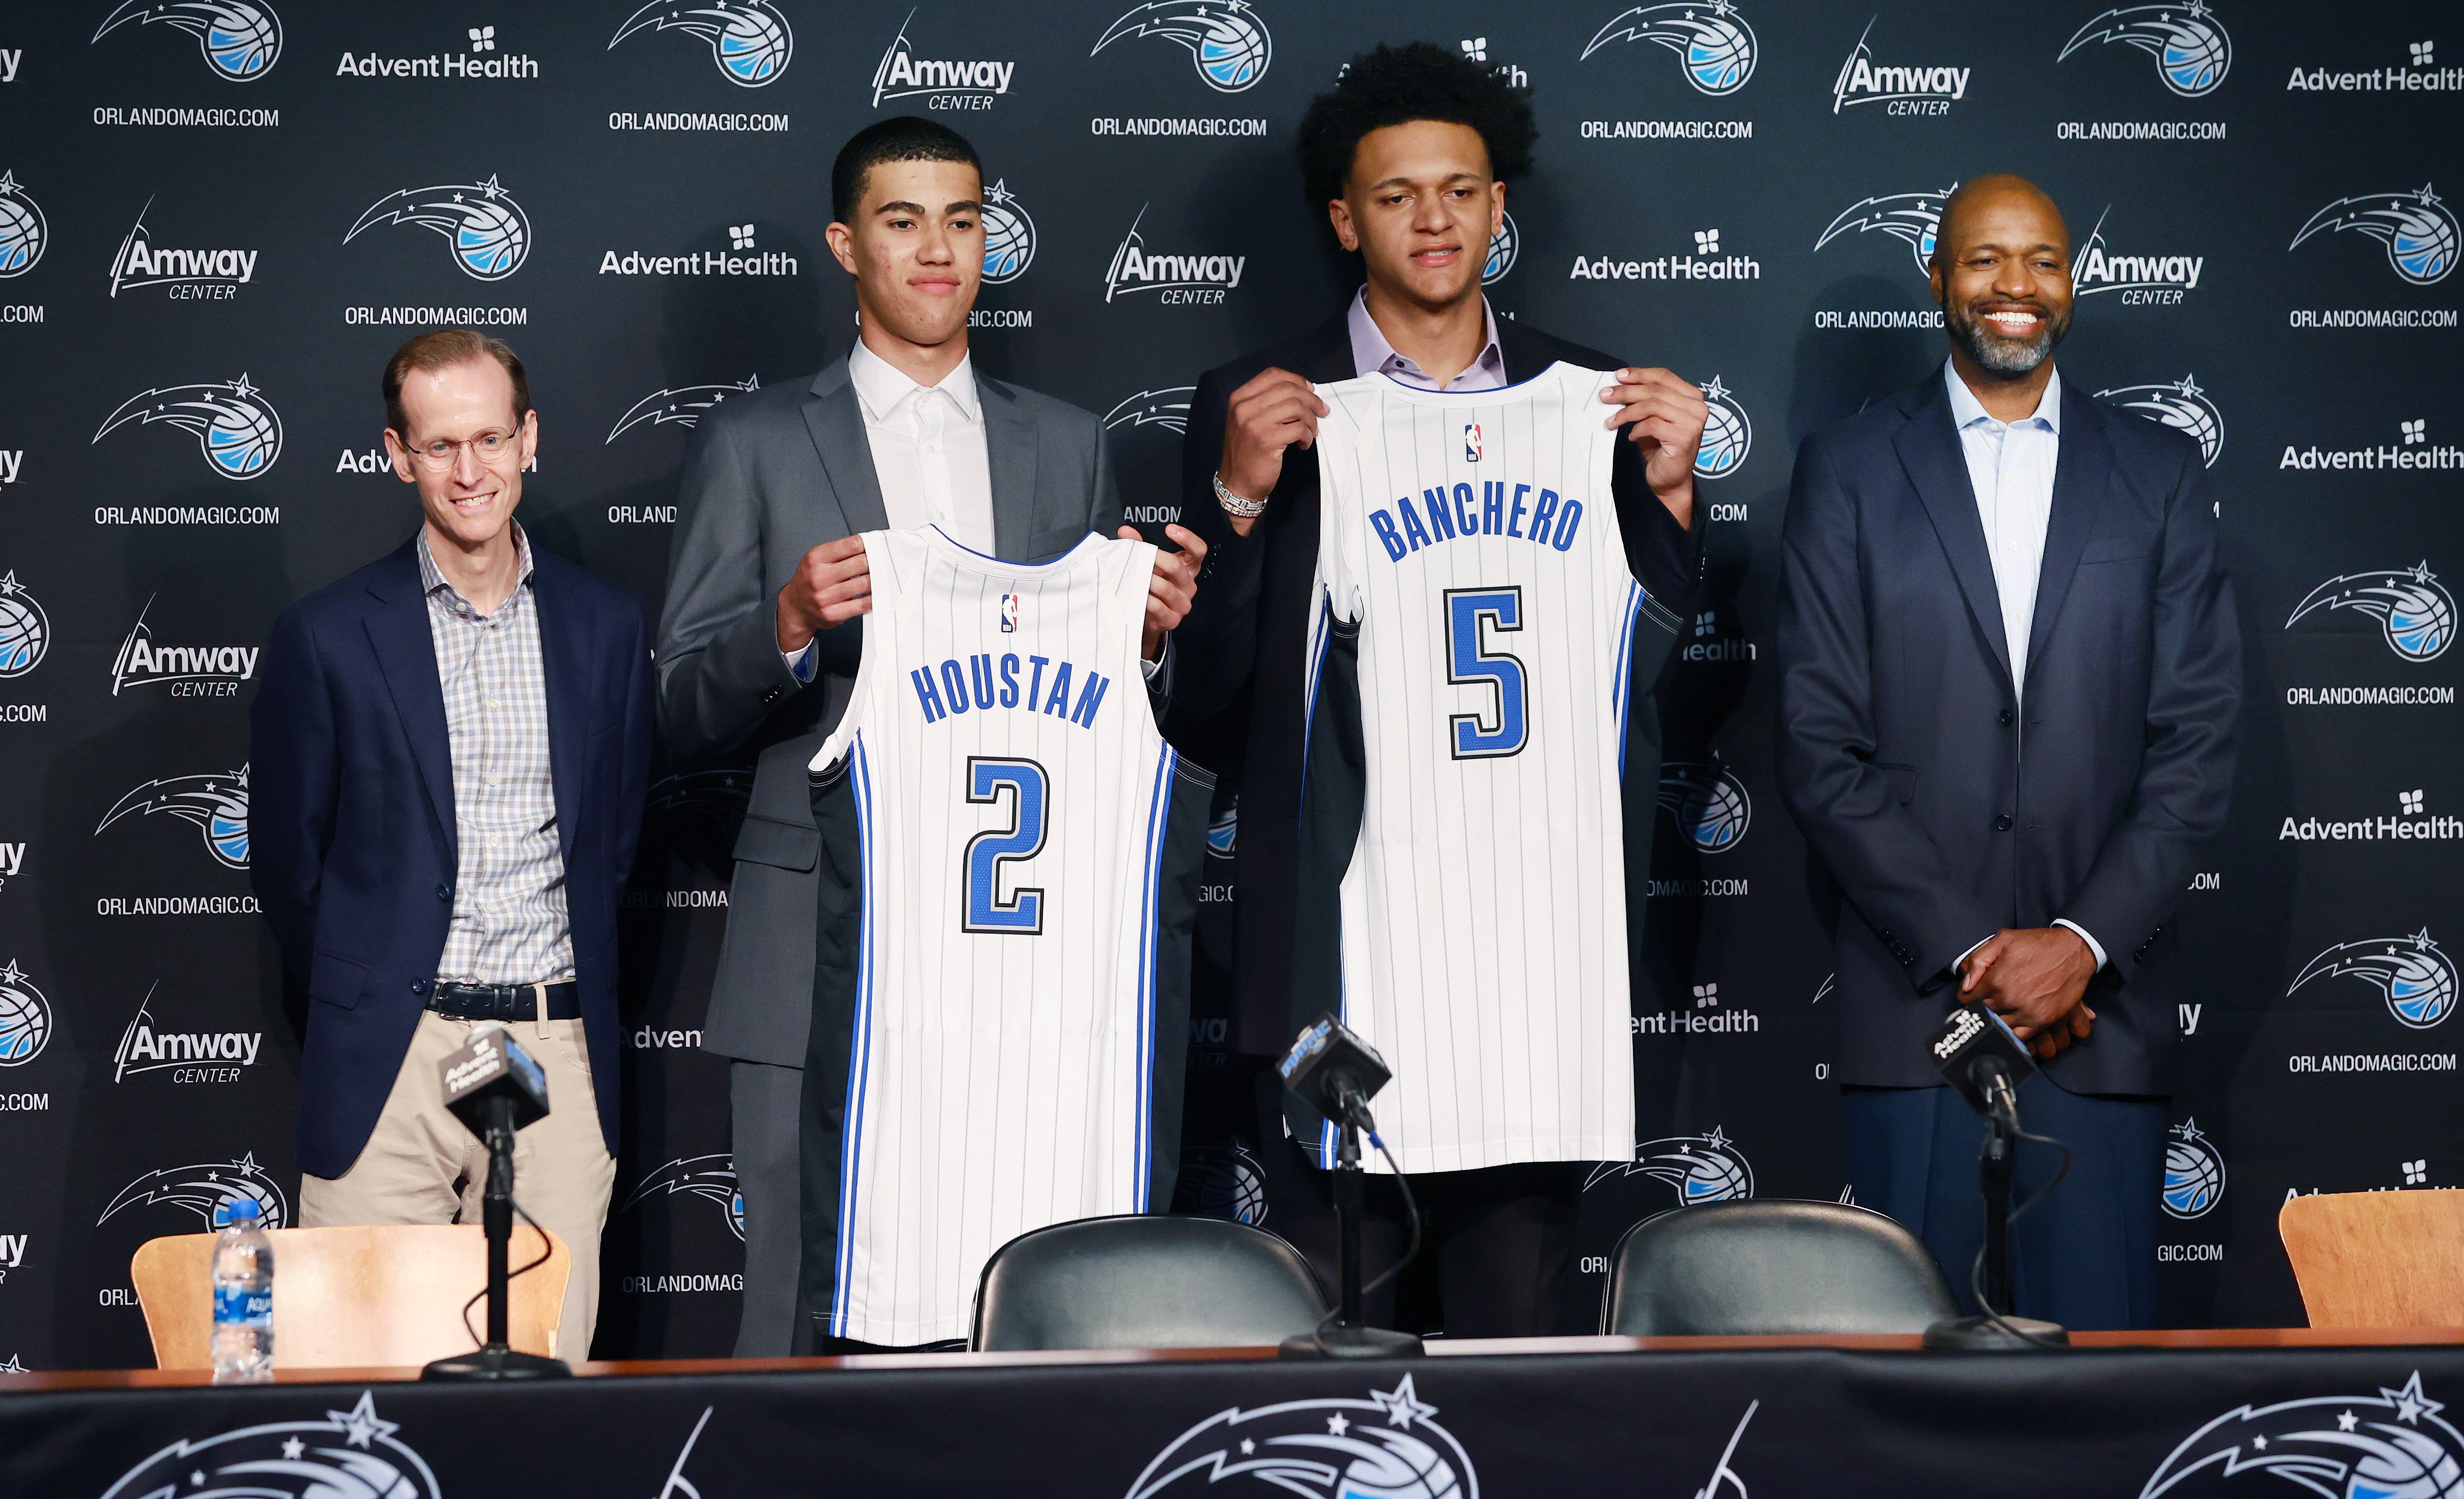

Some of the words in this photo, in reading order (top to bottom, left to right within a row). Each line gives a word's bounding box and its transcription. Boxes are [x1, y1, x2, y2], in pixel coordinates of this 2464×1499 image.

[887, 52, 1015, 94] Amway
[1848, 58, 1971, 100] Amway
[929, 95, 994, 110] CENTER
[1887, 101, 1950, 116] CENTER
[94, 107, 279, 127] ORLANDOMAGIC.COM
[609, 112, 788, 132] ORLANDOMAGIC.COM
[1092, 118, 1266, 136] ORLANDOMAGIC.COM
[1580, 121, 1752, 139] ORLANDOMAGIC.COM
[2057, 122, 2226, 140] ORLANDOMAGIC.COM
[126, 240, 258, 283] Amway
[1120, 247, 1245, 288] Amway
[2083, 248, 2203, 289] Amway
[169, 285, 236, 300] CENTER
[1161, 290, 1225, 304] CENTER
[2122, 290, 2184, 305] CENTER
[345, 307, 527, 325] ORLANDOMAGIC.COM
[1815, 311, 1945, 328] ORLANDOMAGIC
[2290, 310, 2457, 328] ORLANDOMAGIC.COM
[95, 507, 279, 525] ORLANDOMAGIC.COM
[1369, 481, 1583, 563] BANCHERO
[128, 638, 259, 680] Amway
[1443, 585, 1529, 760] 5
[171, 682, 238, 696] CENTER
[911, 653, 1110, 729] HOUSTAN
[2287, 687, 2454, 705] ORLANDOMAGIC.COM
[962, 755, 1050, 936] 2
[97, 896, 263, 915] ORLANDOMAGIC.C
[130, 1026, 261, 1065] Amway
[2289, 1053, 2456, 1073] ORLANDOMAGIC.COM
[174, 1068, 240, 1083] CENTER
[623, 1274, 743, 1293] ORLANDOMAG
